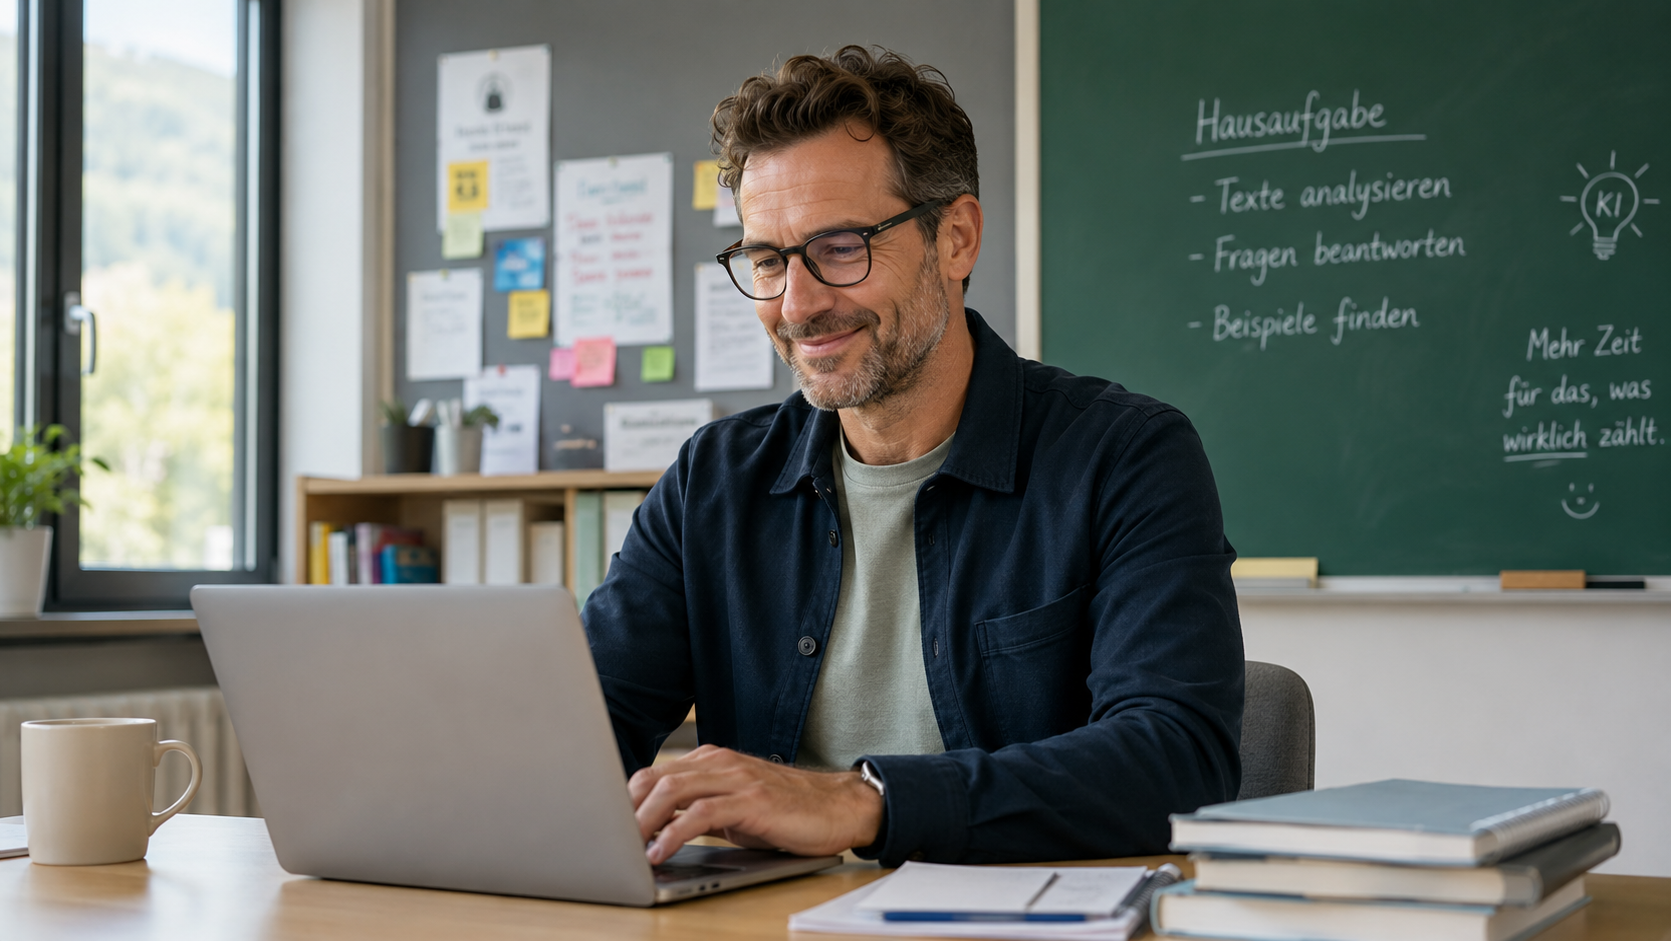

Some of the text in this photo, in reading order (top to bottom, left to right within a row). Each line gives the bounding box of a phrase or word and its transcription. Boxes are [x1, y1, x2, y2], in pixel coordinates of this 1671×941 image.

[1195, 89, 1387, 153] Hausaufgabe
[1214, 176, 1286, 215] Texte
[1300, 168, 1452, 221] analysieren
[1595, 190, 1622, 218] KI
[1213, 234, 1299, 287] Fragen
[1313, 227, 1467, 267] beantworten
[1212, 303, 1318, 351] Beispiele
[1329, 295, 1421, 346] finden
[1526, 324, 1642, 362] Mehr Zeit
[1502, 374, 1652, 419] für das, was
[1503, 416, 1666, 453] wirklich zählt.
